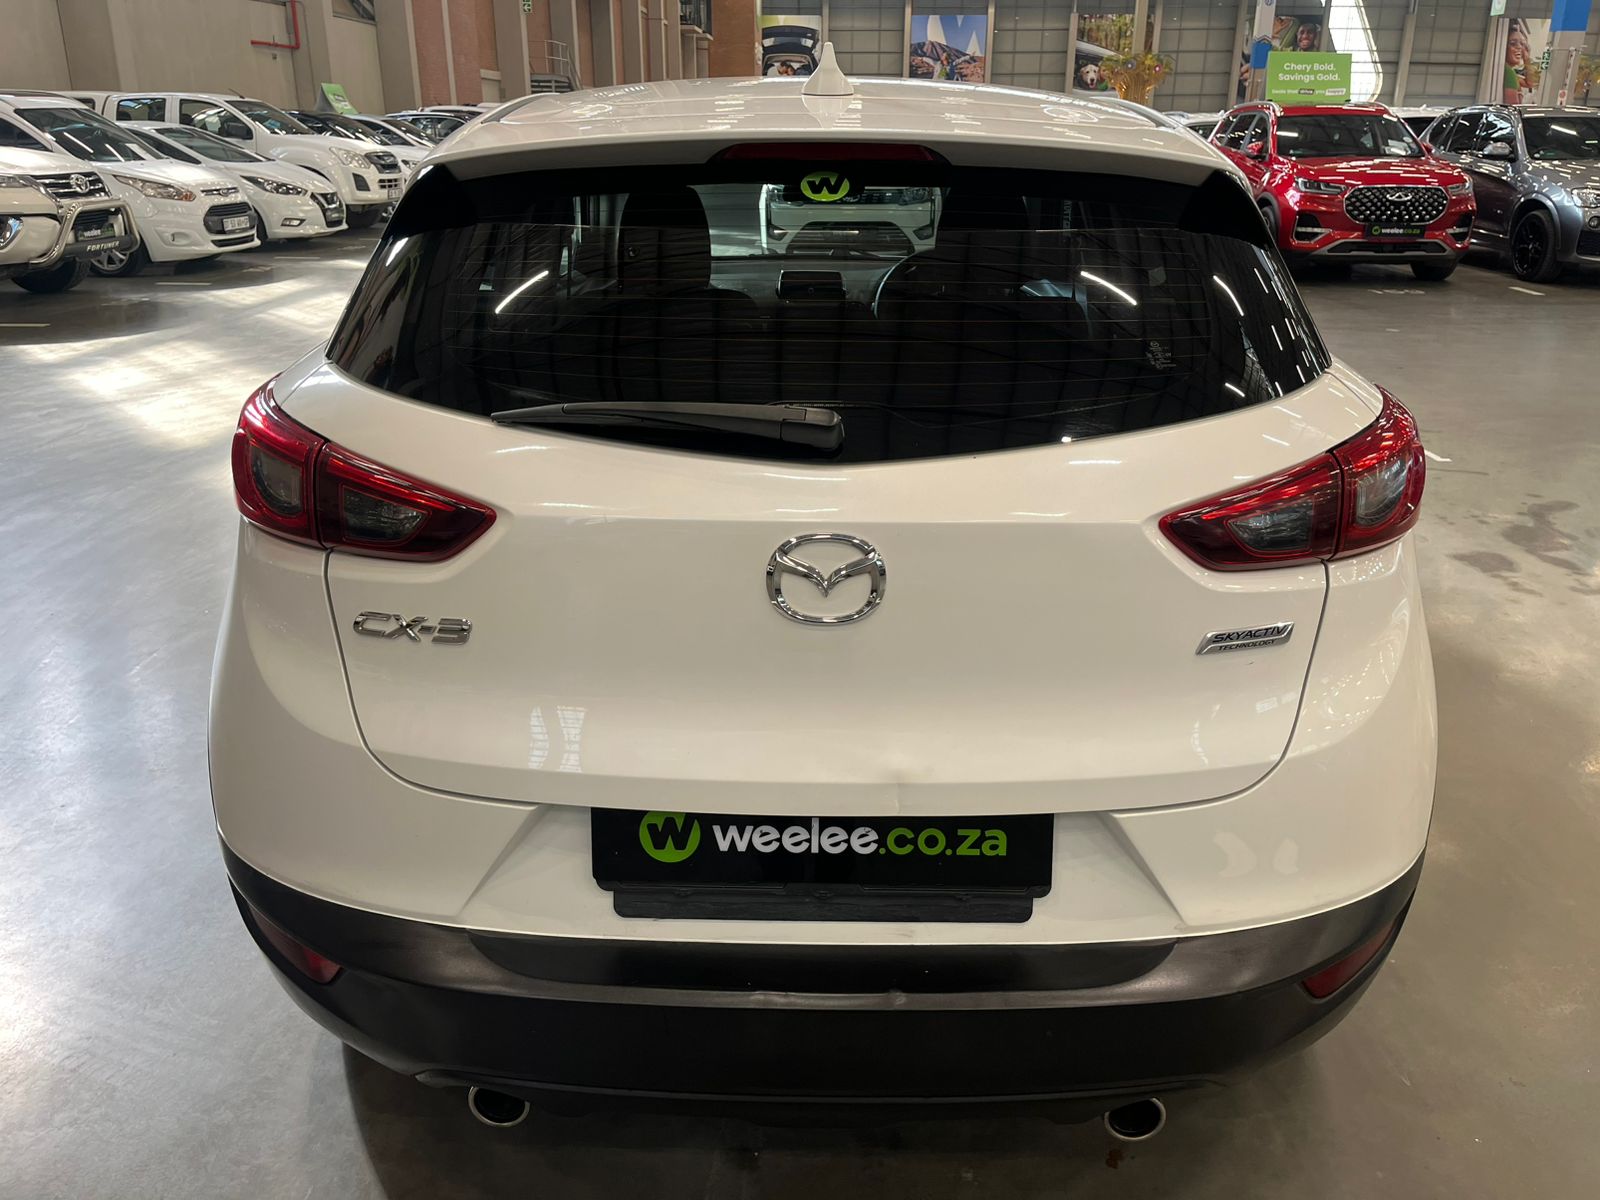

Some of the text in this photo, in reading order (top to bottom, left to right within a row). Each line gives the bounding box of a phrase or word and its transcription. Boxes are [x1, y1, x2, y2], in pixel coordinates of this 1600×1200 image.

[1283, 63, 1336, 72] Chery Bold.
[1278, 73, 1340, 83] Savings Gold.
[87, 241, 120, 251] FORTUNER
[353, 611, 472, 645] CX-3
[1212, 625, 1288, 643] SKYACTIV
[1219, 639, 1276, 651] TECHNOLOGY
[712, 817, 1007, 856] weelee.co.za
